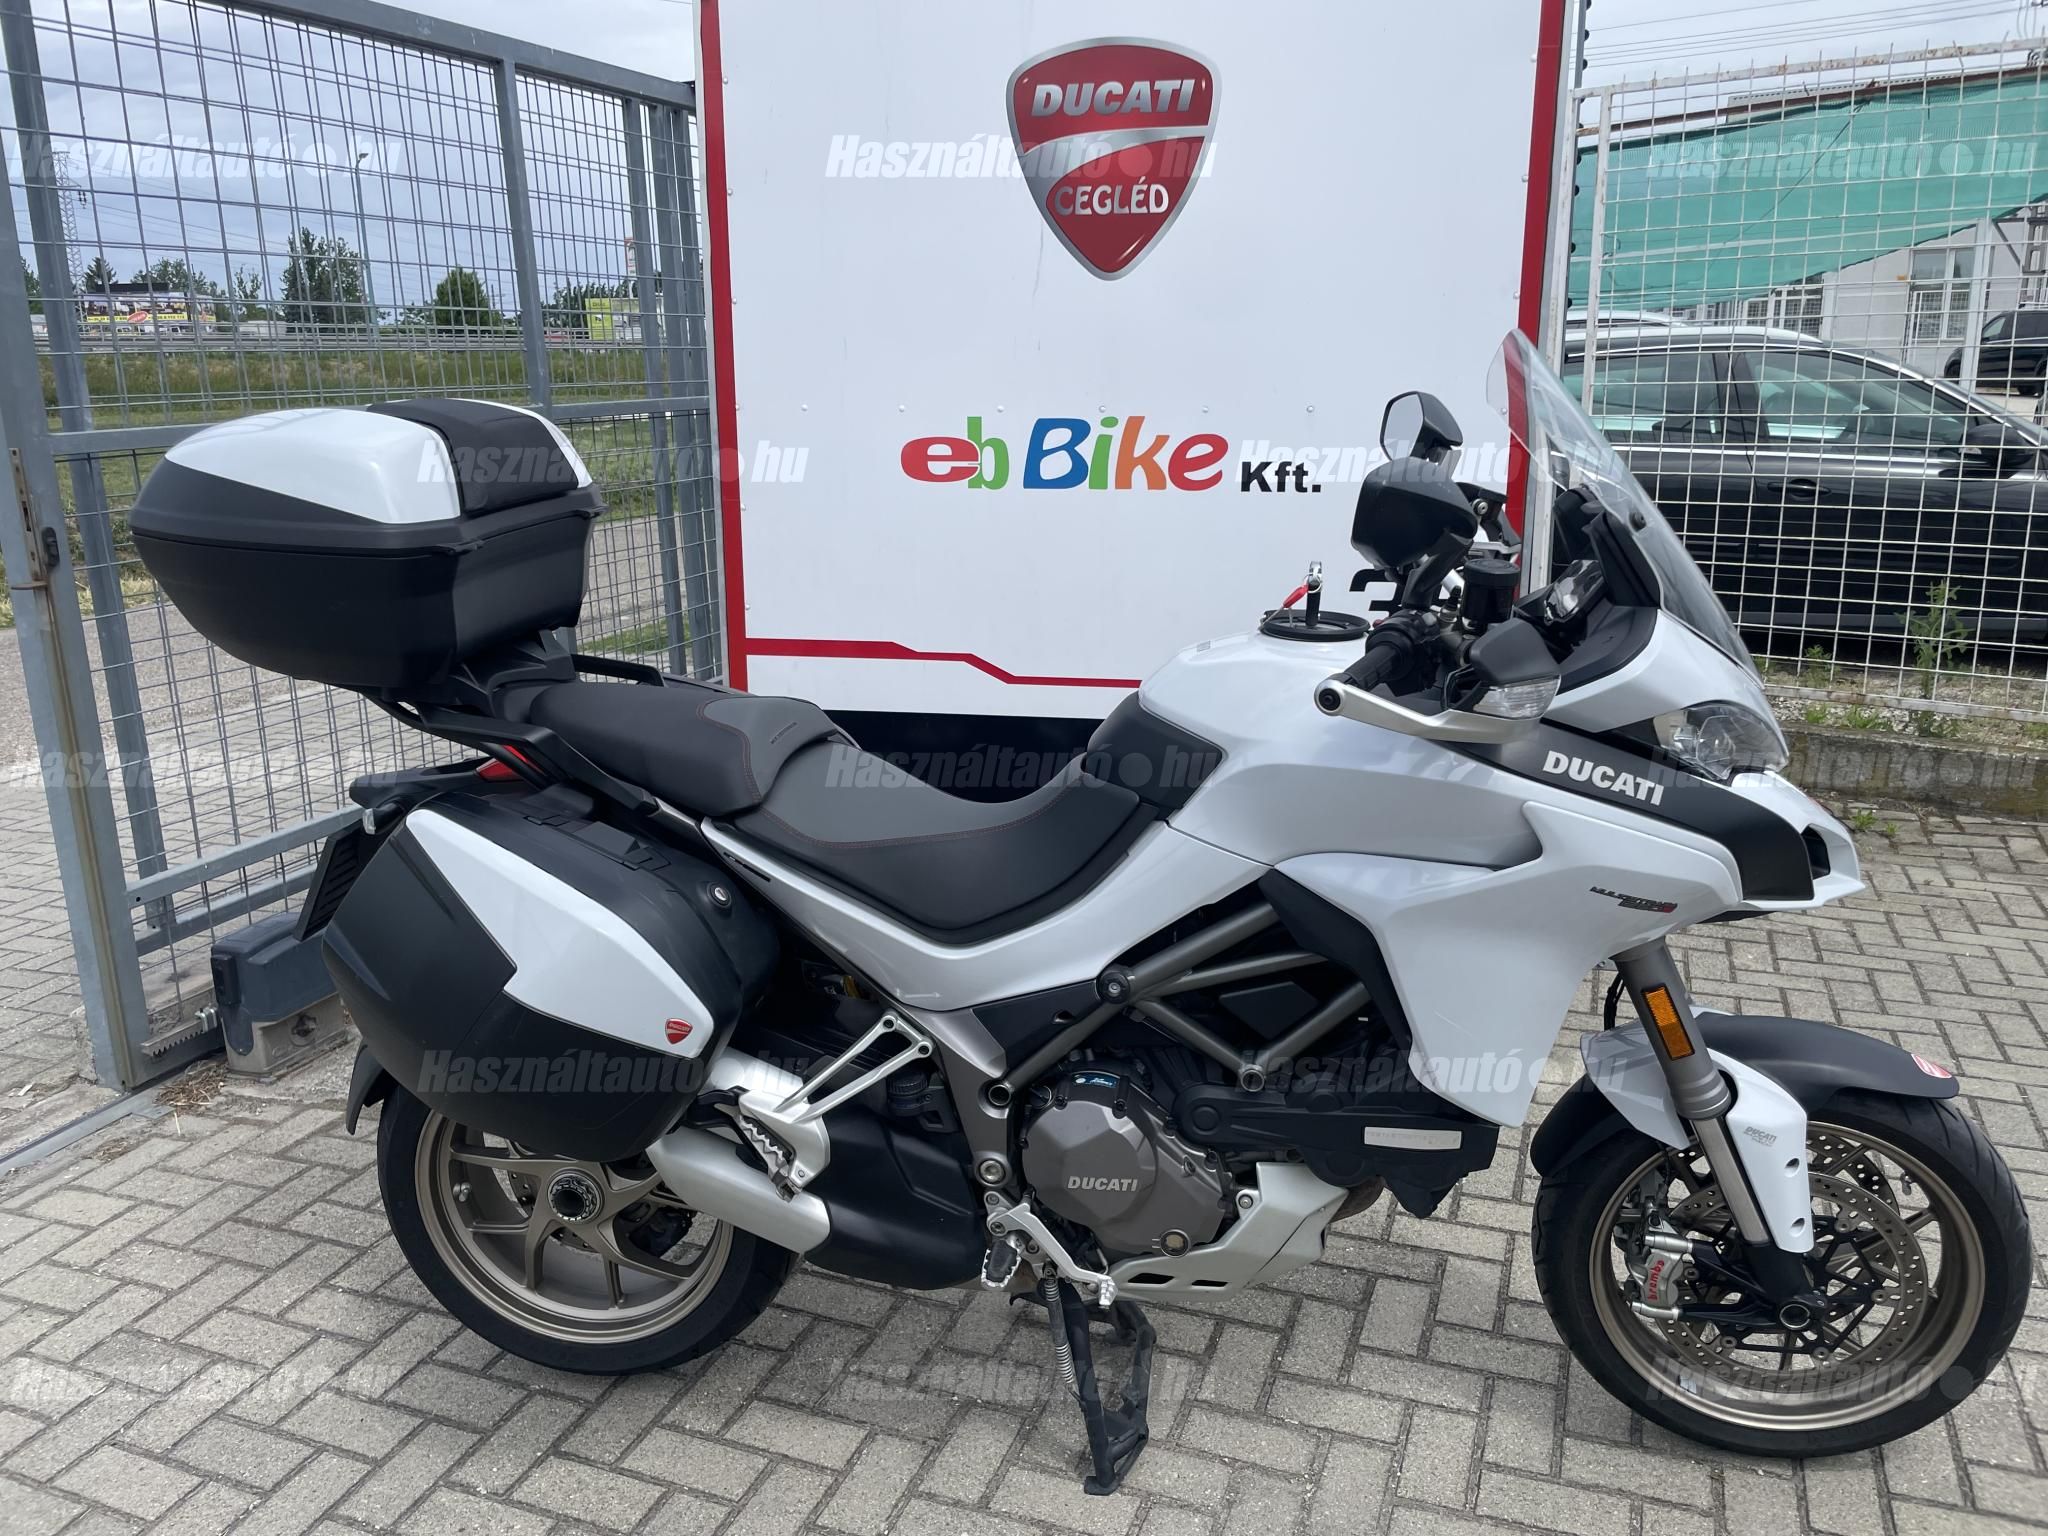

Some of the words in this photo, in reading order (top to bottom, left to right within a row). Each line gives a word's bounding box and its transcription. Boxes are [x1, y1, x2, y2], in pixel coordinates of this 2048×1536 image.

[1031, 79, 1196, 117] DUCATI
[1053, 175, 1170, 216] CEGLÉD
[1240, 460, 1322, 494] Kft.
[1543, 750, 1665, 807] DUCATI
[1067, 1175, 1139, 1192] DUCATI
[1647, 1259, 1665, 1301] brembo
